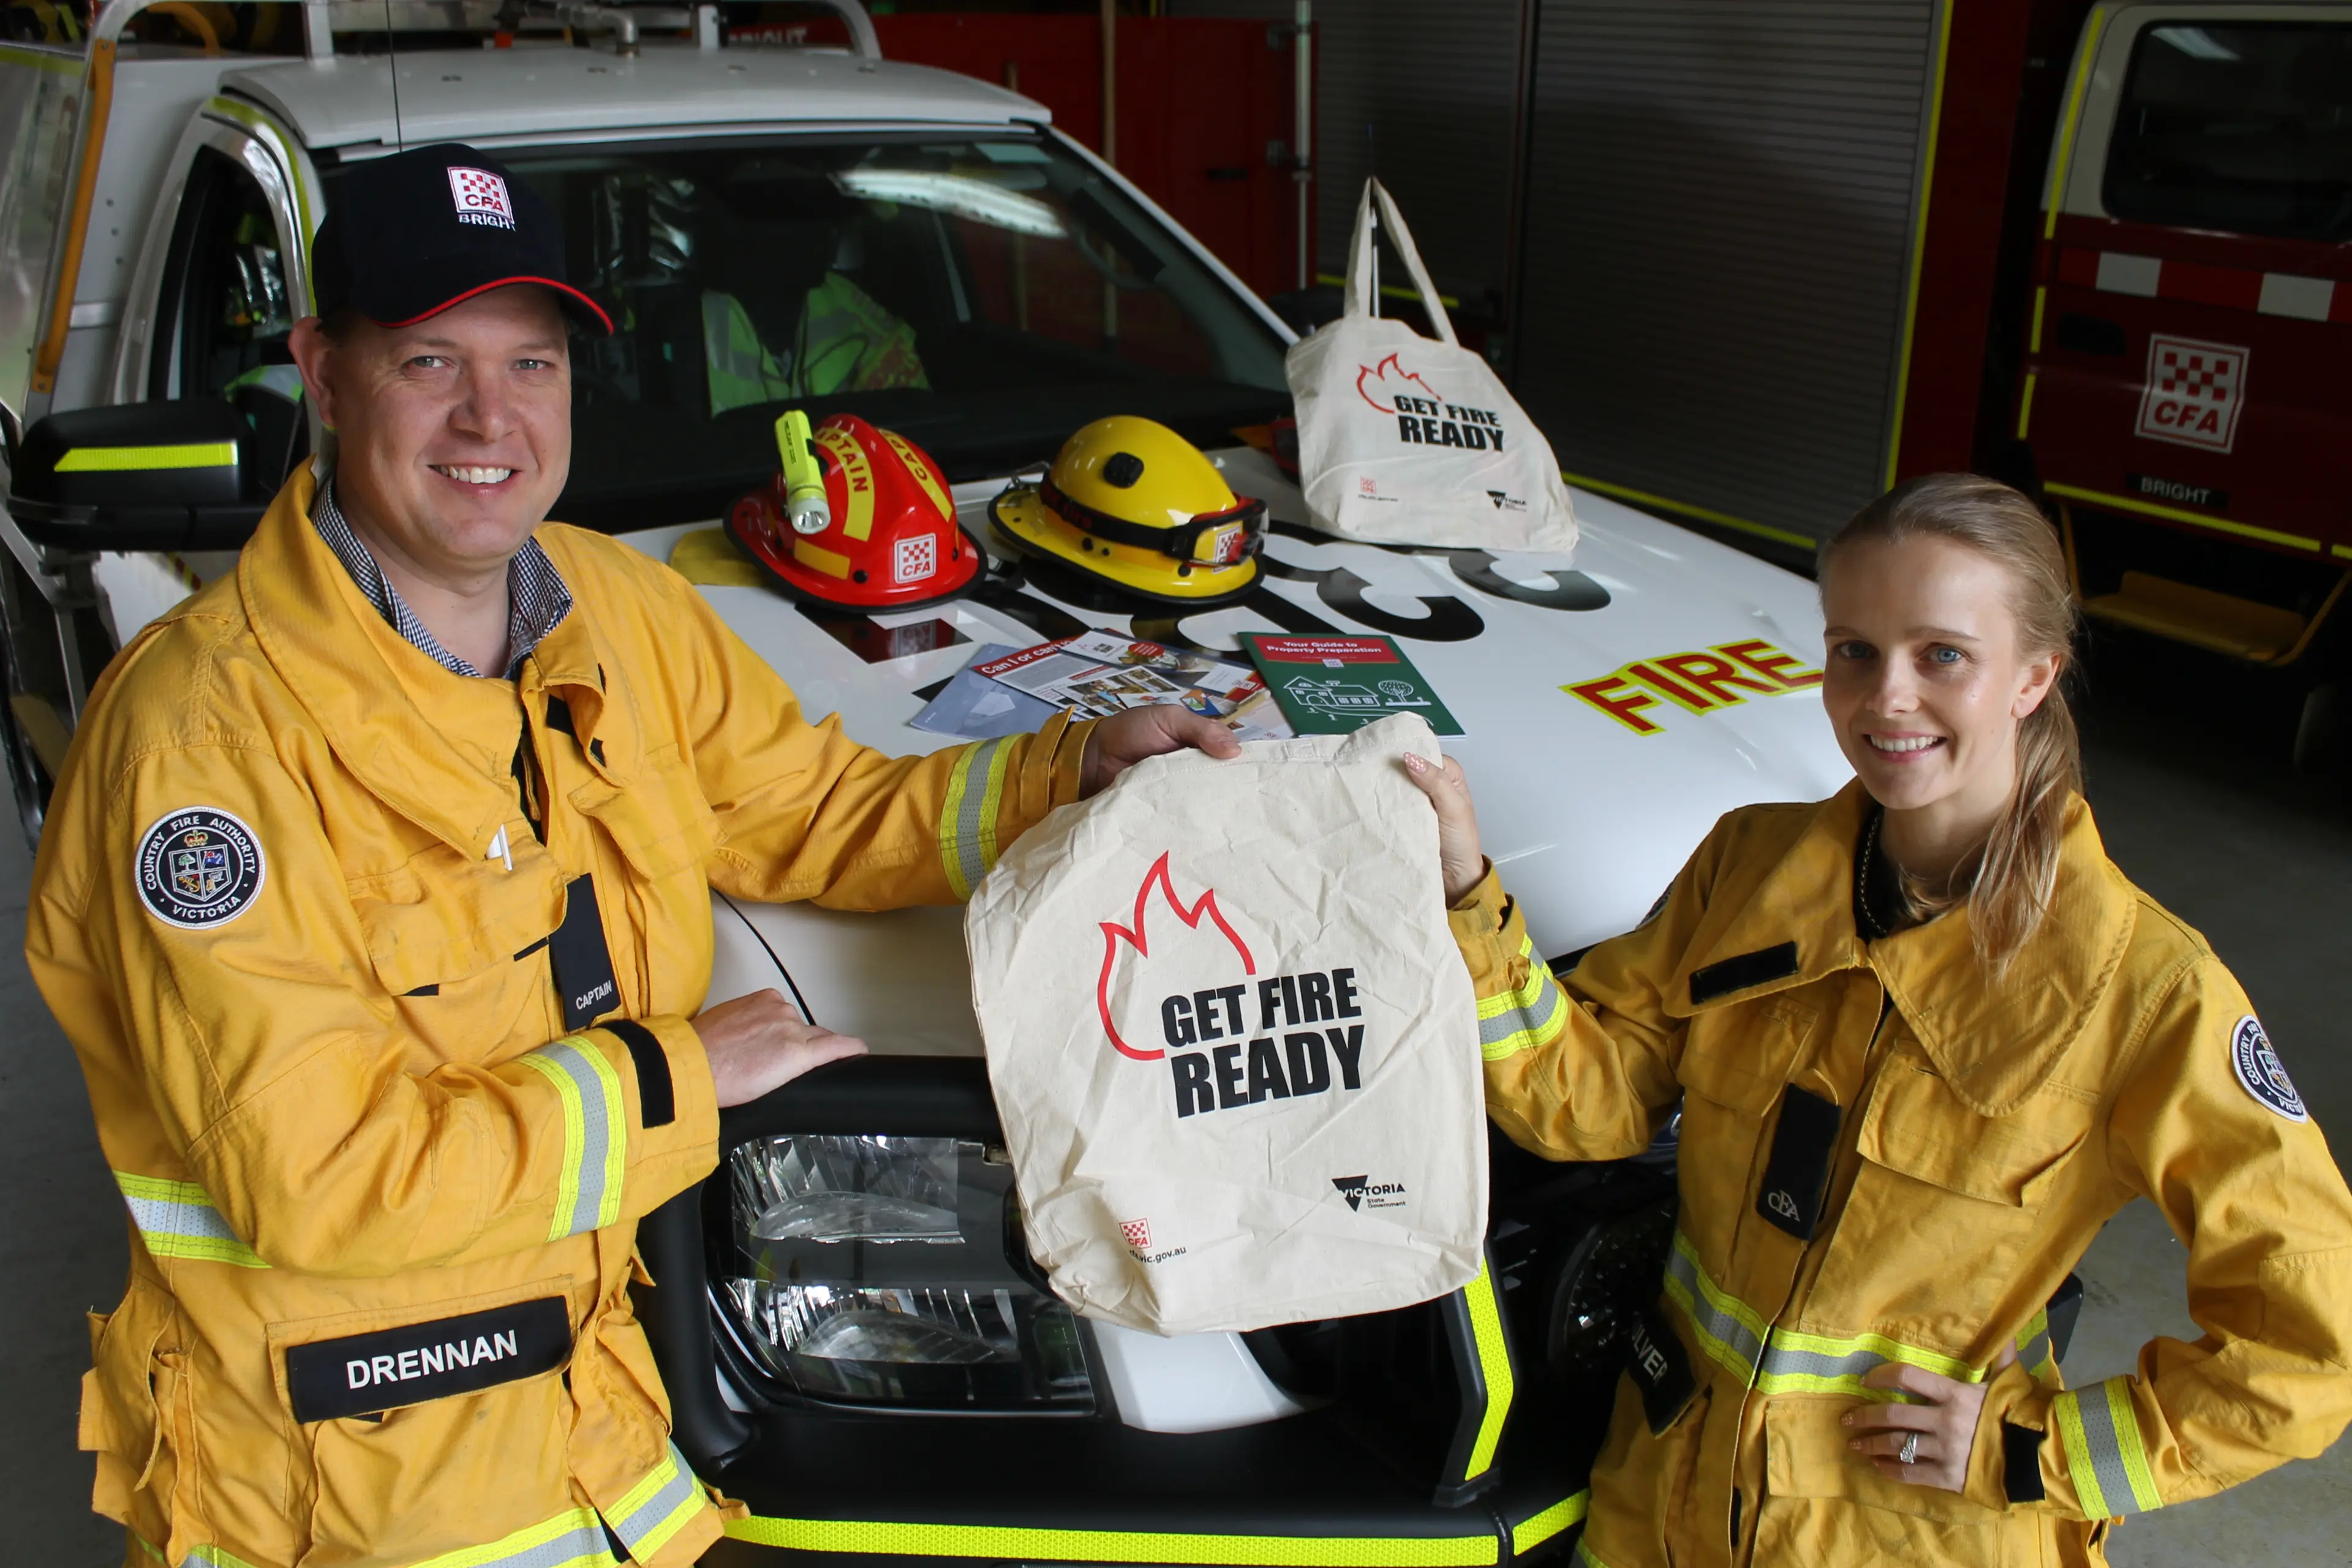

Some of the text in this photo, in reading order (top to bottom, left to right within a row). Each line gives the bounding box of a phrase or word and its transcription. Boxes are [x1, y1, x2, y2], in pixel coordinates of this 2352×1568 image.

[465, 195, 504, 213] CFA
[1394, 395, 1502, 428] GET FIRE
[2154, 401, 2218, 434] CFA
[1398, 415, 1504, 452] READY
[2140, 477, 2211, 505] BRIGHT
[903, 561, 931, 576] CFA
[981, 663, 1012, 674] Can
[1017, 653, 1033, 663] or
[1561, 638, 1824, 735] FIRE
[144, 815, 255, 890] COUNTRY FIRE AUTHORITY
[173, 896, 241, 919] VICTORIA
[576, 980, 612, 1010] CAPTAIN
[1161, 968, 1362, 1047] GET FIRE
[1170, 1024, 1365, 1118] READY
[2241, 1035, 2260, 1085] COUNTRY
[1339, 1183, 1406, 1198] VICTORIA
[1128, 1237, 1148, 1246] CFA
[347, 1330, 518, 1389] DRENNAN
